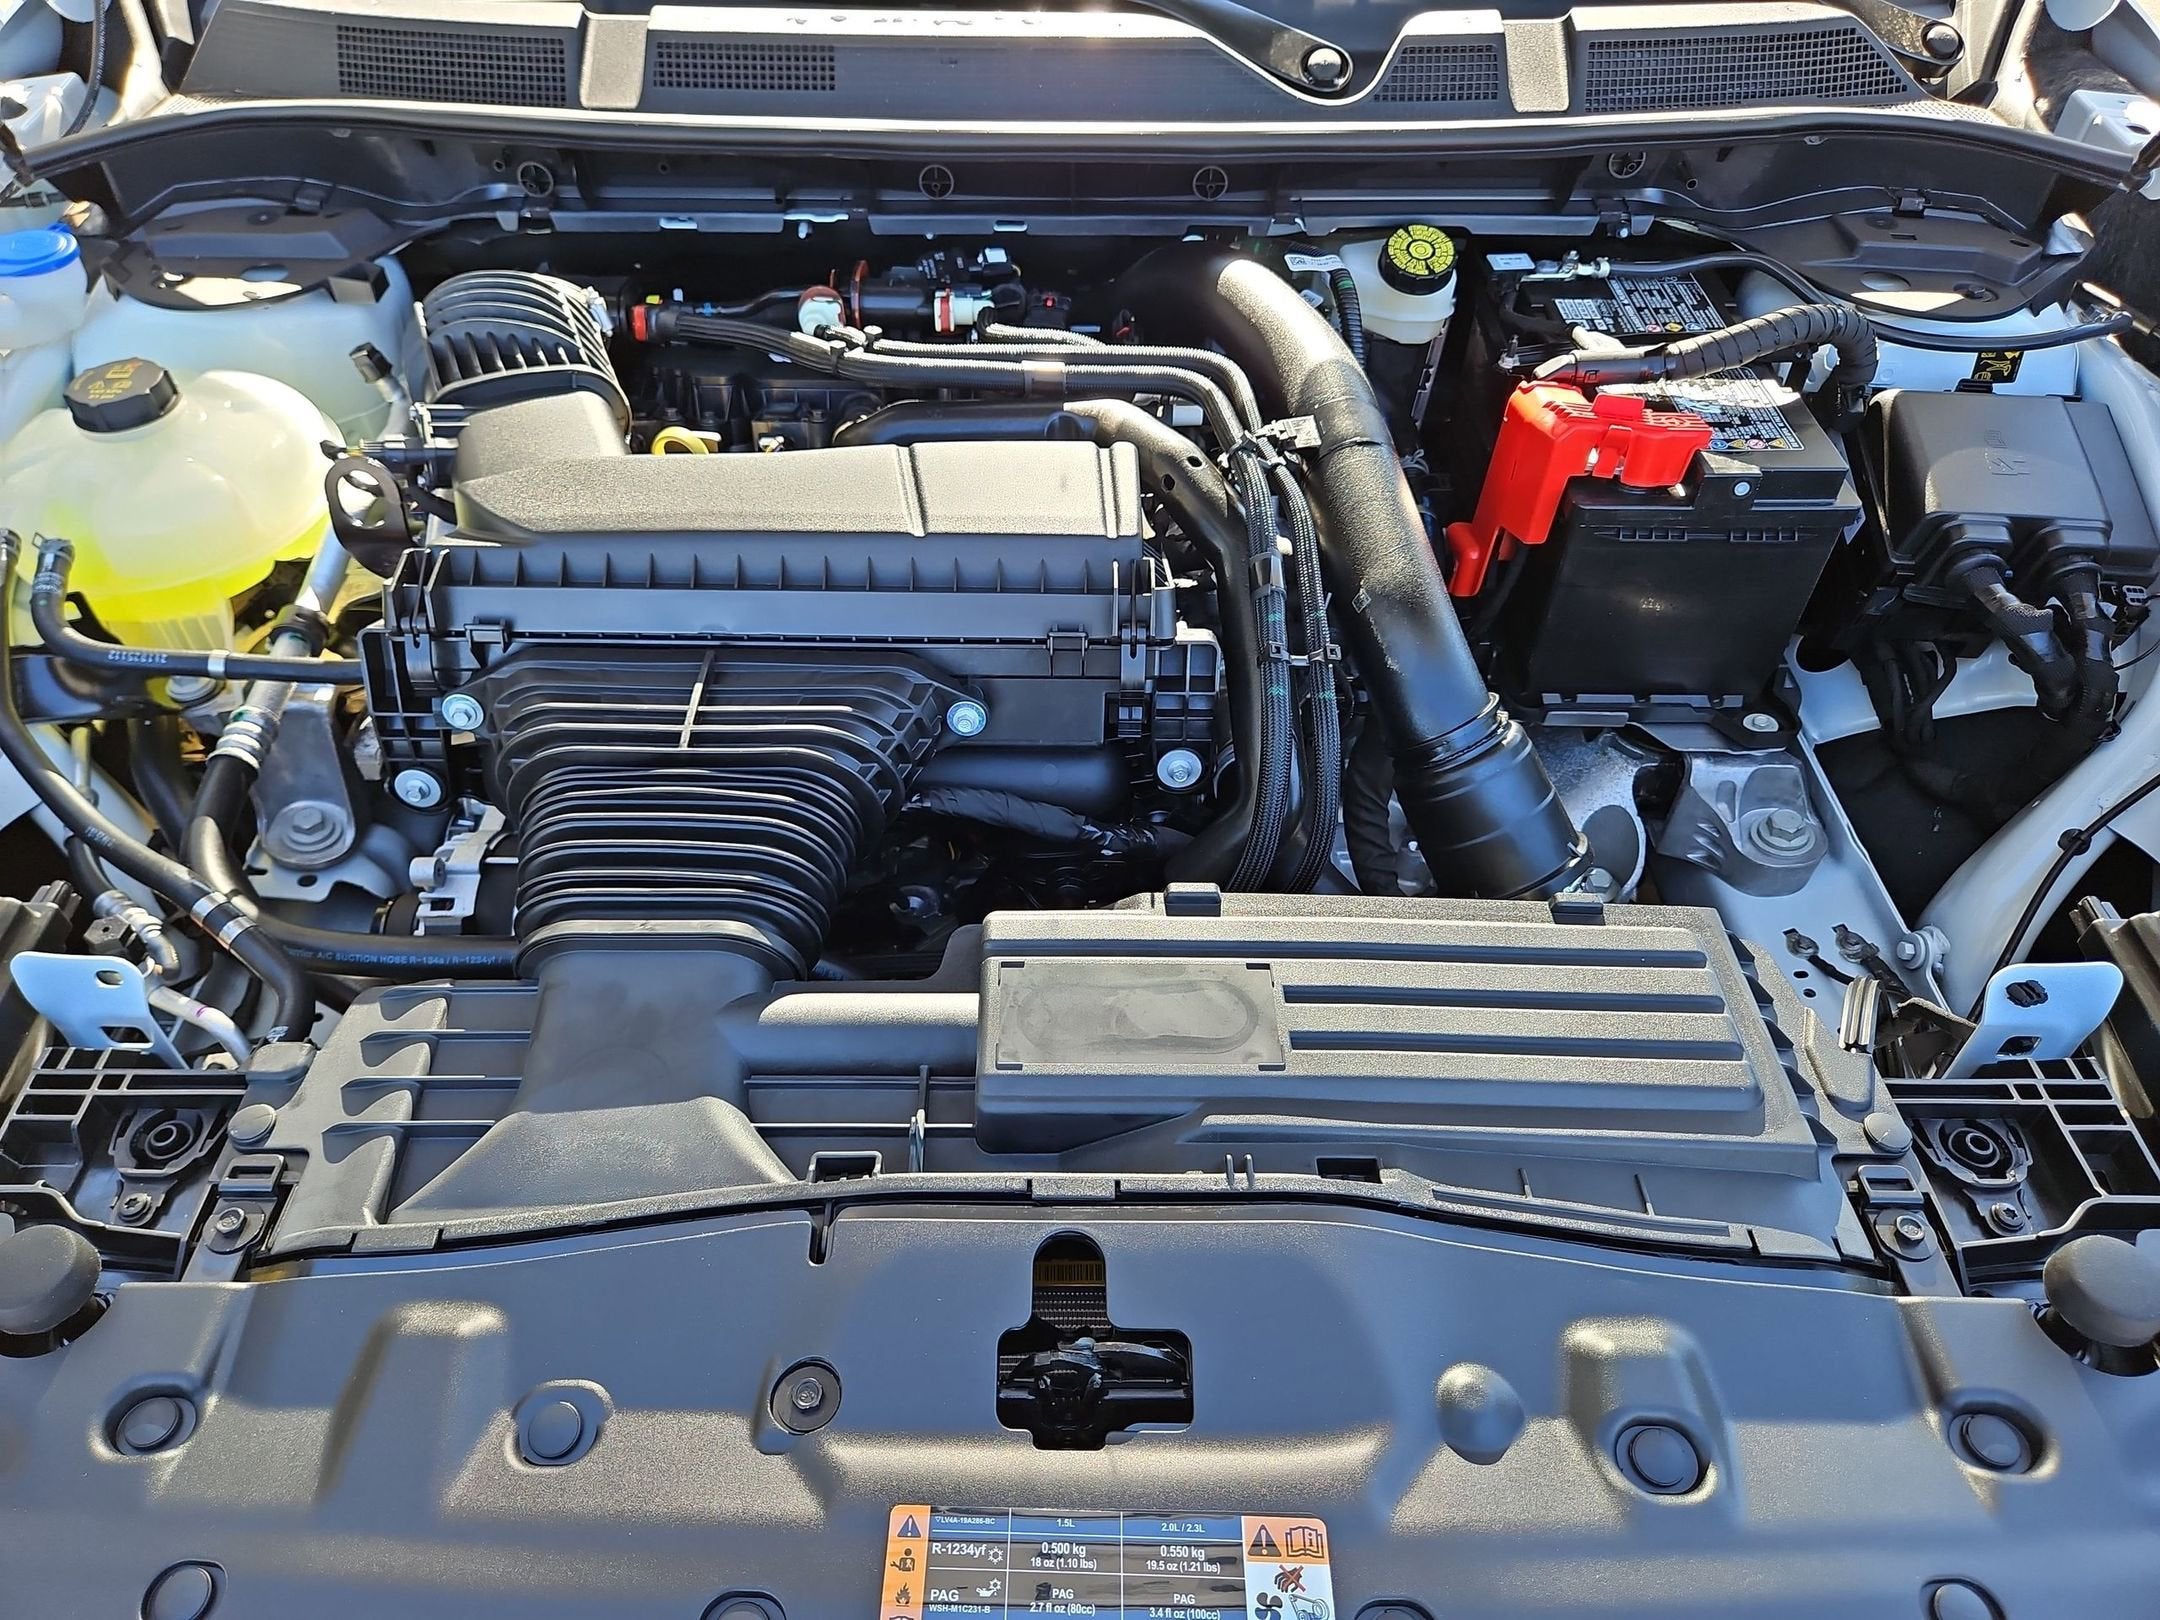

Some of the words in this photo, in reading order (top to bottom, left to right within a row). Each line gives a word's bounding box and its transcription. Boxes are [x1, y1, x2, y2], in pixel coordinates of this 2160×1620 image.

[335, 952, 377, 963] SUCTION
[379, 954, 408, 964] HOSE
[1056, 1518, 1076, 1528] 1.5L
[1161, 1522, 1180, 1532] 2.0L
[1186, 1523, 1206, 1533] 2.3L
[931, 1542, 988, 1558] R-1234yf
[1041, 1542, 1070, 1554] 0.500
[1072, 1543, 1087, 1558] kg
[1160, 1545, 1189, 1558] 0.550
[1191, 1546, 1205, 1561] kg
[1030, 1557, 1042, 1567] 18
[1043, 1559, 1055, 1568] oz
[1056, 1558, 1078, 1570] (1.10
[1080, 1559, 1097, 1571] lbs)
[1146, 1560, 1165, 1571] 19.5
[1166, 1563, 1178, 1571] oz
[1179, 1561, 1201, 1573] (1.21
[1203, 1562, 1221, 1575] lbs)
[930, 1589, 960, 1602] PAG
[1052, 1588, 1074, 1600] PAG
[1173, 1594, 1196, 1605] PAG
[928, 1604, 991, 1614] WSH-M1C231-B
[1029, 1602, 1044, 1613] 2.7
[1045, 1602, 1053, 1613] fl
[1053, 1606, 1066, 1614] oz
[1067, 1603, 1096, 1616] (80cc)
[1149, 1607, 1163, 1618] 3.4
[1165, 1607, 1172, 1618] fl
[1173, 1610, 1185, 1619] oz
[1186, 1608, 1221, 1620] (100cc)
